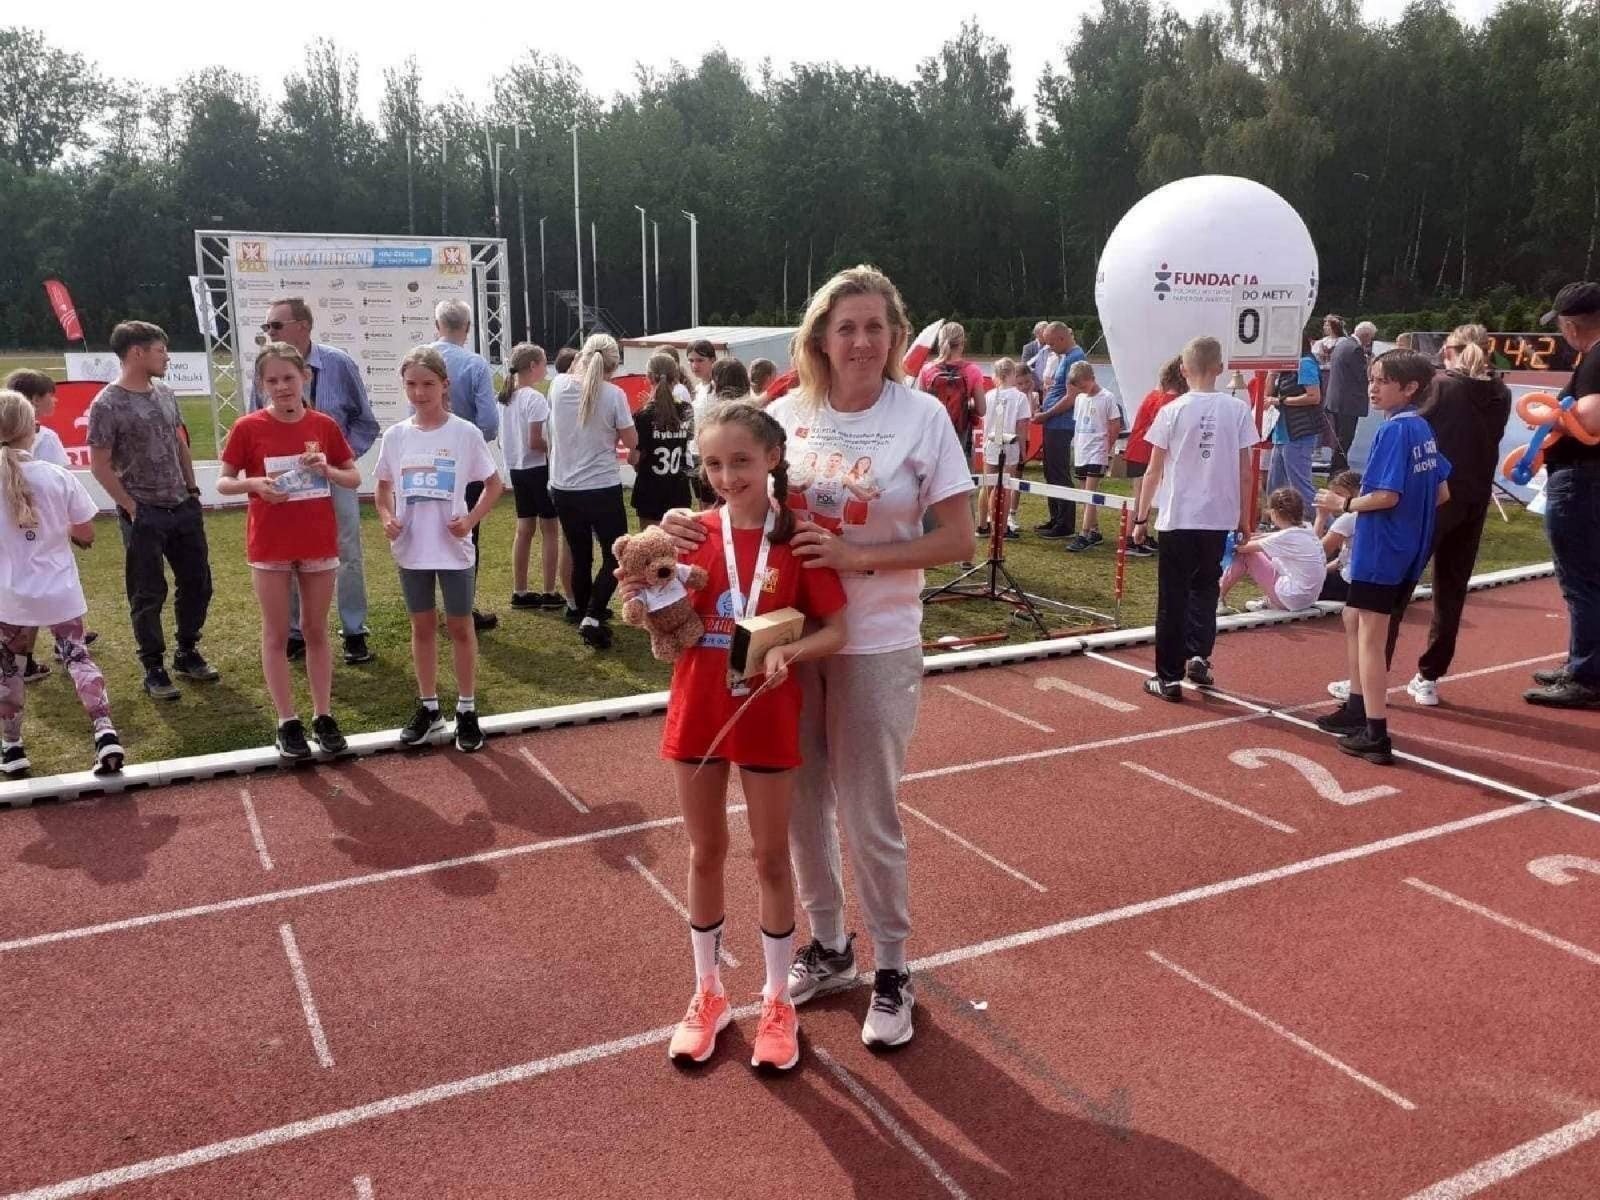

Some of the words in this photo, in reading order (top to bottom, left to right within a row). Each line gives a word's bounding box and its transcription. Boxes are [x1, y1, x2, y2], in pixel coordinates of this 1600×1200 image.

[1242, 290, 1258, 300] DO
[1262, 289, 1293, 300] METY
[1238, 308, 1260, 345] 0
[173, 373, 203, 382] Nauki
[651, 446, 682, 476] 30
[412, 472, 438, 487] 66
[1033, 677, 1139, 713] 1
[1227, 747, 1402, 806] 2
